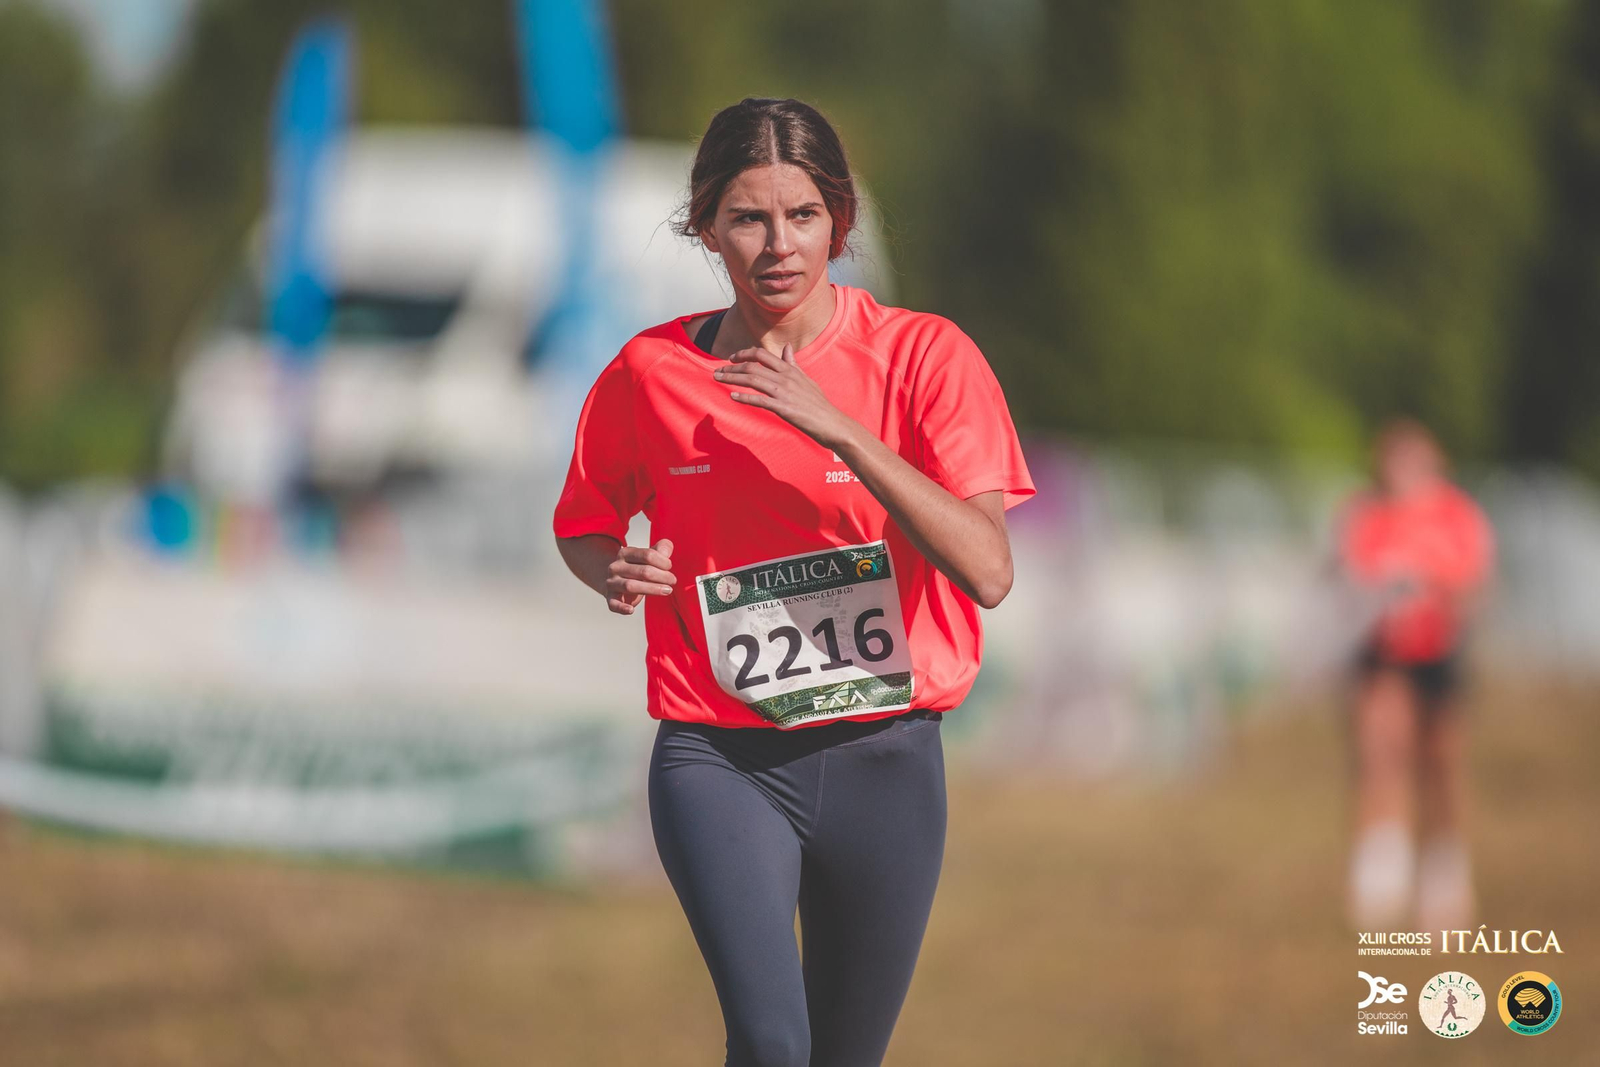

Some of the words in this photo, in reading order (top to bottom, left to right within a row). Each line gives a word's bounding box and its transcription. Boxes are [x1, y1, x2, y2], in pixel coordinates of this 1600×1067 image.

[697, 464, 711, 474] CLUB
[753, 557, 843, 591] ITÁLICA
[747, 600, 782, 613] SEVILLA
[782, 594, 820, 606] RUNNING
[821, 589, 843, 599] CLUB
[843, 586, 854, 596] (2)
[726, 607, 894, 691] 2216
